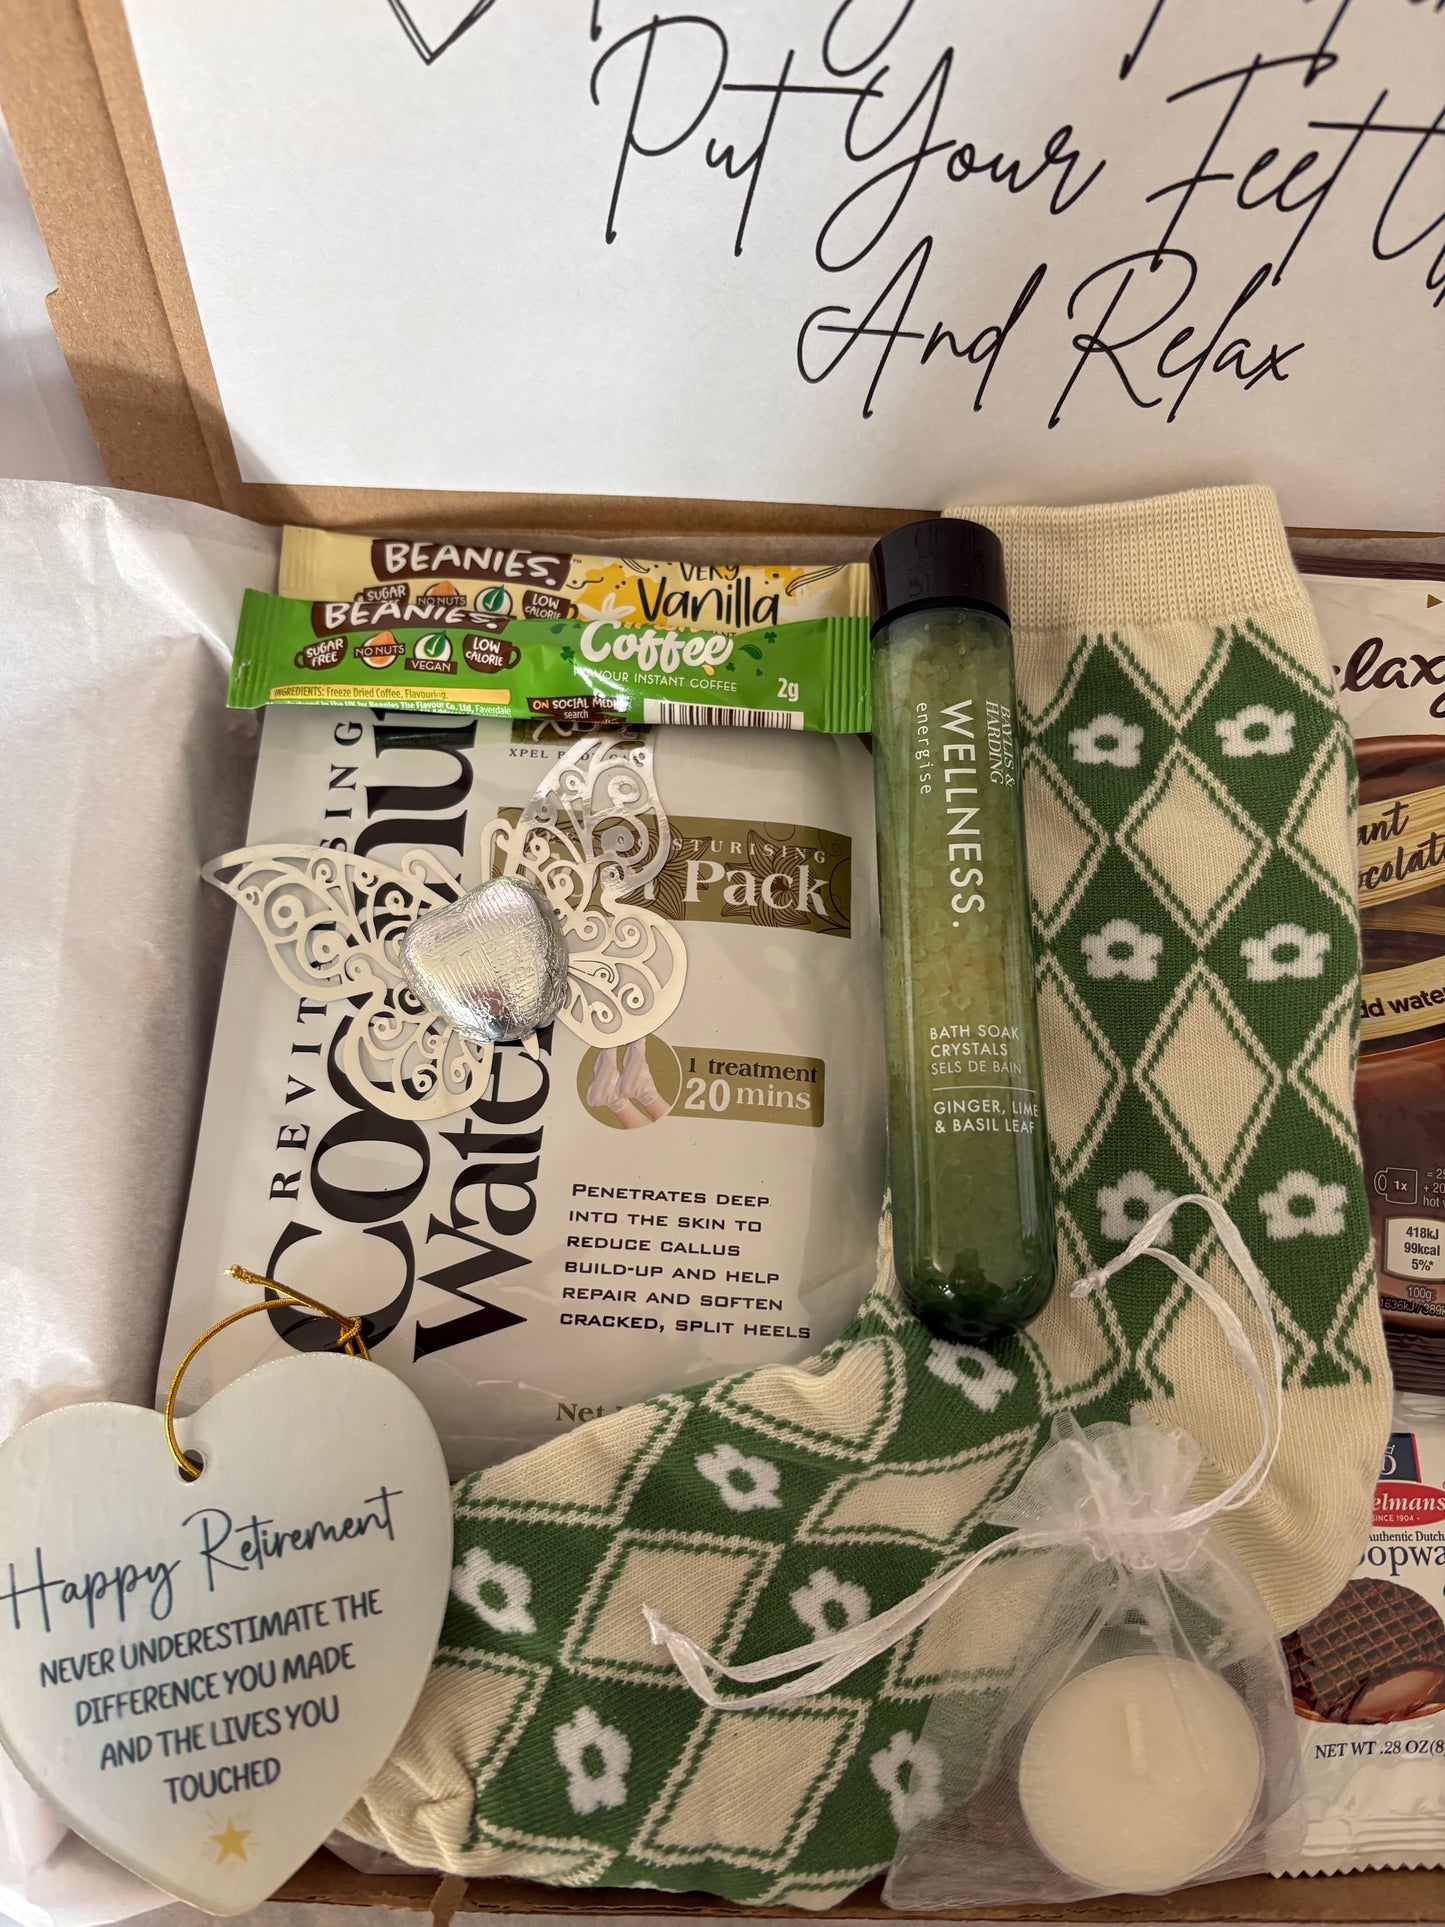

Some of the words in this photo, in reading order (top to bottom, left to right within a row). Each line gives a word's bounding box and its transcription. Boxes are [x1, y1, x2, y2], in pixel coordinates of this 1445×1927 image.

[592, 15, 883, 256] Put
[816, 47, 1105, 272] Your
[1147, 53, 1445, 286] Feet
[797, 237, 1046, 418] And
[1049, 248, 1305, 428] Relax
[367, 585, 407, 601] SUGAR
[418, 597, 435, 606] NO
[440, 596, 466, 606] NUTS
[533, 594, 560, 610] LOW
[637, 576, 779, 629] Vanilla
[306, 638, 344, 658] SUGAR
[355, 647, 373, 657] NO
[376, 645, 404, 656] NUTS
[473, 637, 500, 654] LOW
[580, 621, 733, 673] Coffee
[312, 652, 338, 667] FREE
[411, 660, 451, 672] VEGAN
[465, 651, 503, 667] CALORIE
[634, 673, 685, 687] INSTANT
[690, 679, 737, 692] COFFEE
[777, 678, 799, 702] 2g
[274, 686, 325, 697] INGREDIENTS:
[326, 688, 351, 697] Freeze
[353, 688, 374, 698] Dried
[375, 688, 404, 699] Coffee,
[400, 701, 415, 709] The
[475, 704, 512, 715] Faverdale
[532, 700, 549, 710] ON
[552, 697, 589, 710] SOCIAL
[563, 709, 589, 720] search
[985, 700, 1004, 785] HARDING
[1000, 705, 1014, 770] BAYLIS
[509, 748, 549, 759] XPEL
[915, 702, 934, 795] energise
[1005, 773, 1016, 788] &
[939, 699, 985, 928] WELLNESS.
[682, 859, 830, 916] Pack
[930, 1025, 970, 1040] BATH
[978, 1024, 1020, 1040] SOAK
[930, 1042, 1008, 1058] CRYSTALS
[688, 1058, 696, 1073] 1
[708, 1058, 818, 1083] treatment
[931, 1061, 962, 1075] SELS
[968, 1060, 987, 1073] DE
[993, 1061, 1022, 1075] BAIN
[684, 1077, 731, 1112] 20
[736, 1083, 811, 1110] mins
[933, 1099, 1006, 1116] GINGER,
[1012, 1101, 1039, 1118] LIME
[935, 1120, 946, 1134] &
[953, 1118, 999, 1132] BASIL
[1005, 1118, 1035, 1134] LEAF
[1393, 1180, 1408, 1191] 1x
[716, 1193, 770, 1207] DEEP
[1423, 1196, 1440, 1207] hot
[569, 1210, 618, 1224] INTO
[627, 1213, 668, 1227] THE
[678, 1216, 725, 1230] SKIN
[735, 1220, 762, 1232] TO
[1406, 1226, 1439, 1240] 418kJ
[567, 1235, 651, 1251] REDUCE
[660, 1241, 740, 1256] CALLUS
[1404, 1242, 1440, 1256] 99kcal
[564, 1261, 663, 1277] BUILD-UP
[672, 1267, 716, 1281] AND
[726, 1270, 779, 1284] HELP
[562, 1287, 637, 1302] REPAIR
[646, 1292, 690, 1305] AND
[700, 1295, 783, 1311] SOFTEN
[560, 1313, 665, 1333] CRACKED,
[676, 1319, 734, 1334] SPLIT
[743, 1324, 811, 1339] HEELS
[555, 1402, 605, 1422] Net
[1396, 1514, 1414, 1522] 1904
[1415, 1530, 1445, 1542] Dutch
[0, 1547, 181, 1632] Happy
[182, 1486, 403, 1591] Retirement
[39, 1648, 116, 1687] NEVER
[119, 1601, 330, 1670] UNDERESTIMATE
[333, 1589, 383, 1623] THE
[75, 1672, 220, 1727] DIFFERENCE
[223, 1659, 277, 1697] YOU
[282, 1643, 356, 1684] MADE
[100, 1735, 153, 1770] AND
[156, 1723, 206, 1758] THE
[210, 1708, 282, 1746] LIVES
[285, 1695, 340, 1732] YOU
[1315, 1743, 1348, 1759] NET
[1351, 1741, 1376, 1755] WT
[1380, 1741, 1401, 1755] .28
[163, 1757, 281, 1804] TOUCHED
